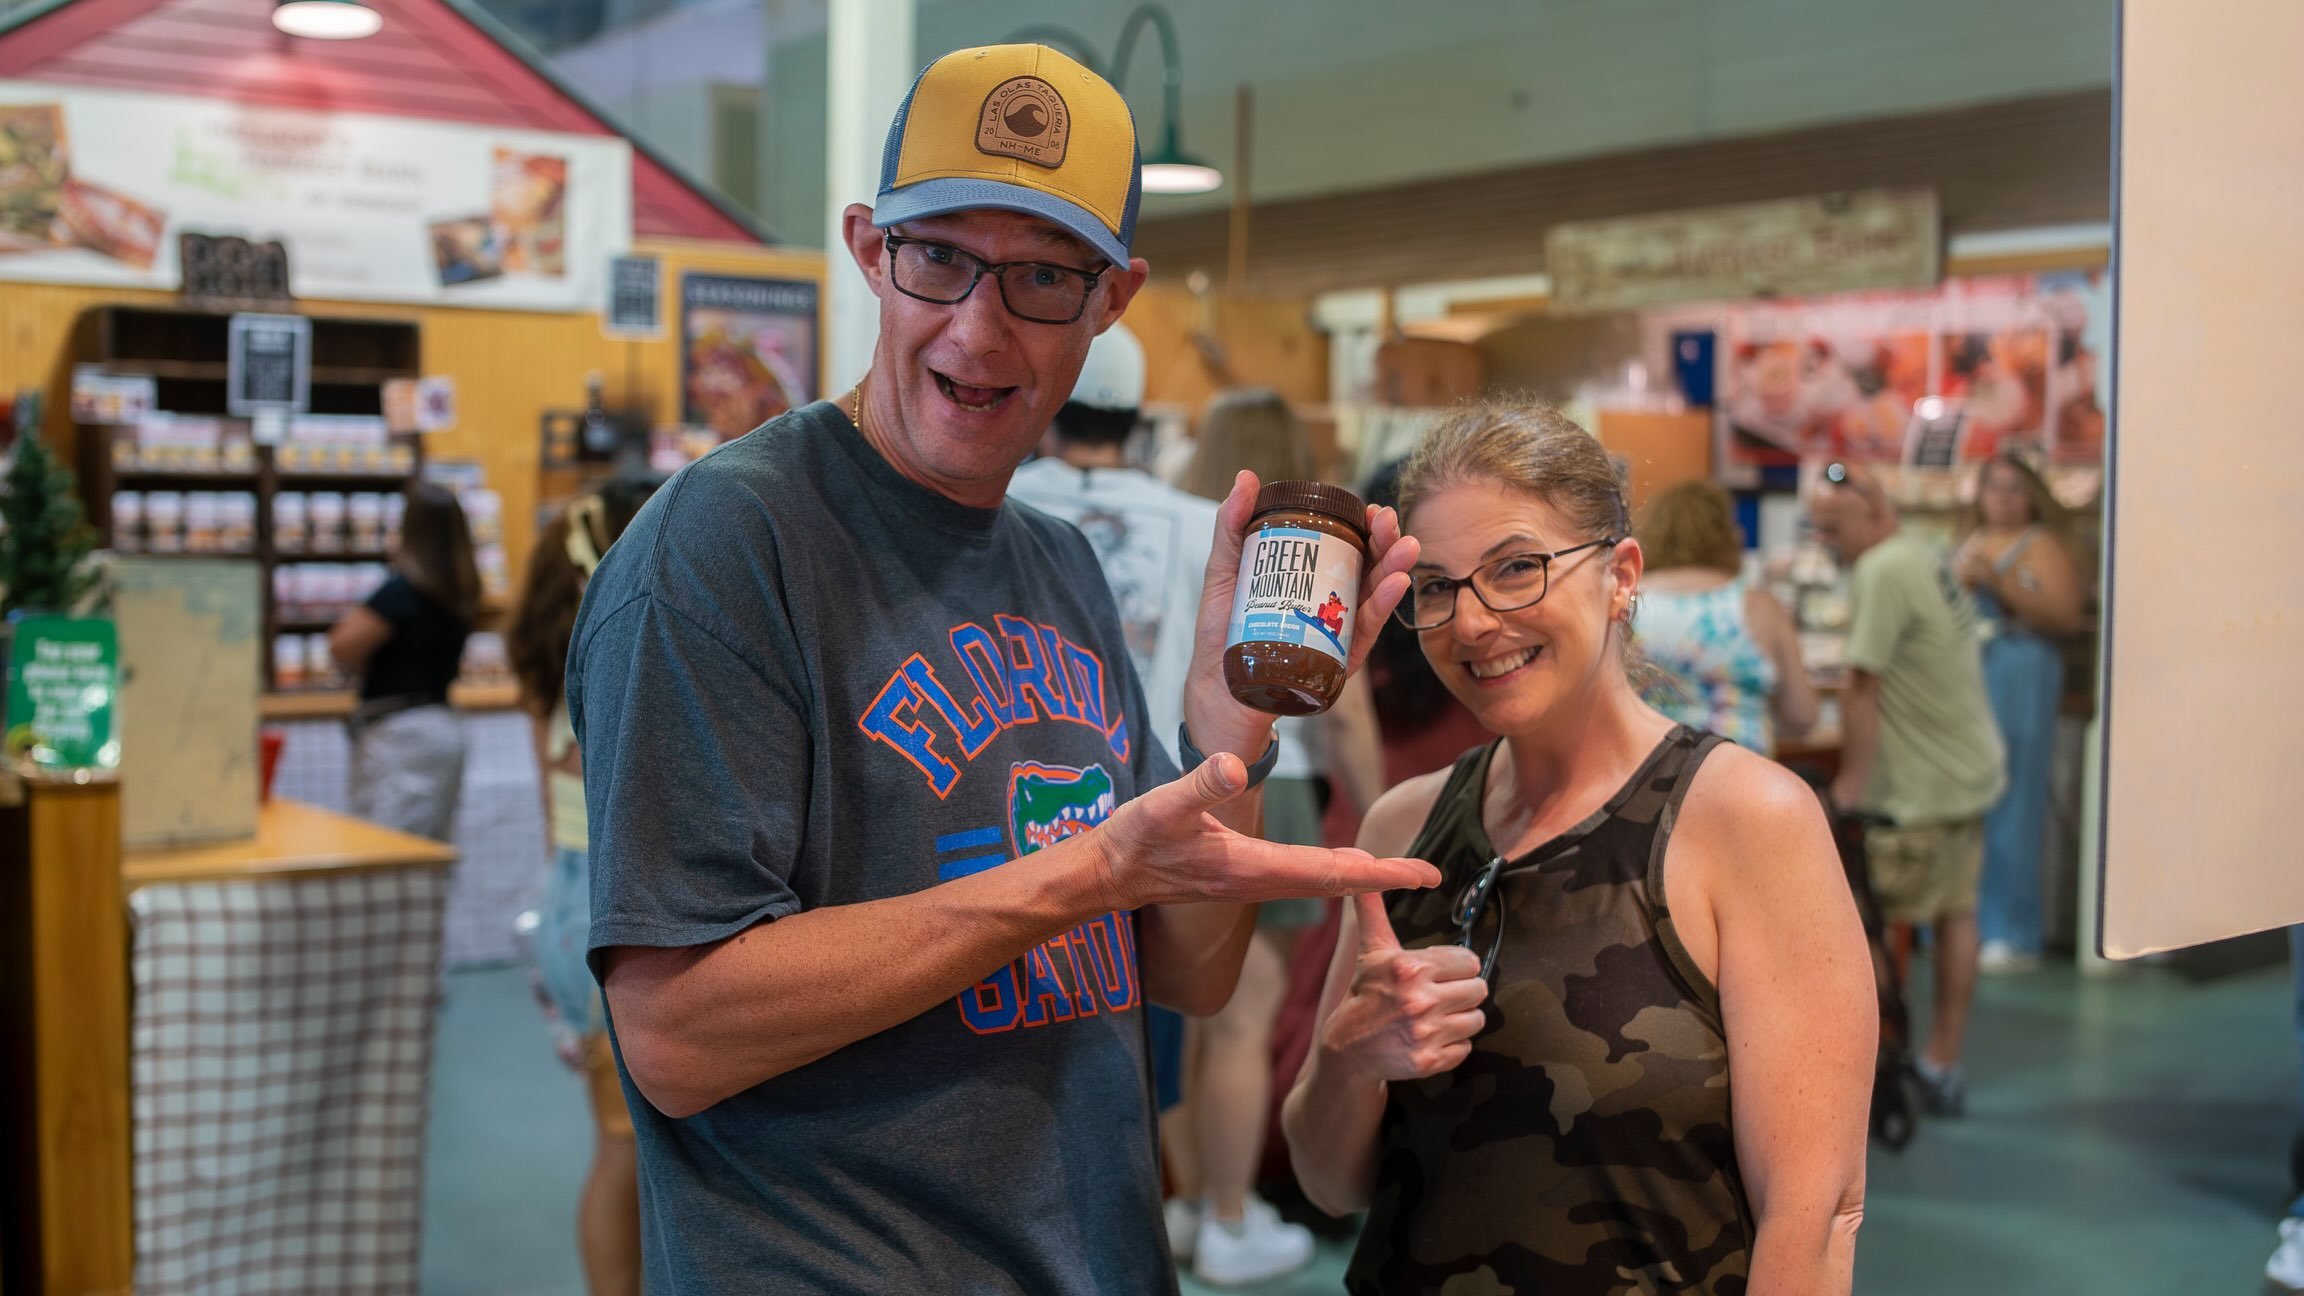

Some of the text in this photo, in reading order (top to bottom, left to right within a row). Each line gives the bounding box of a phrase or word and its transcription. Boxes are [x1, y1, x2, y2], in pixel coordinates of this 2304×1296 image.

[989, 81, 1062, 134] LAS OLAS TAQUERIA
[984, 127, 995, 135] 20
[1253, 540, 1320, 577] GREEN
[1248, 572, 1315, 602] MOUNTAIN
[1244, 599, 1313, 613] Peanut Butter
[957, 909, 1141, 1035] GATO
